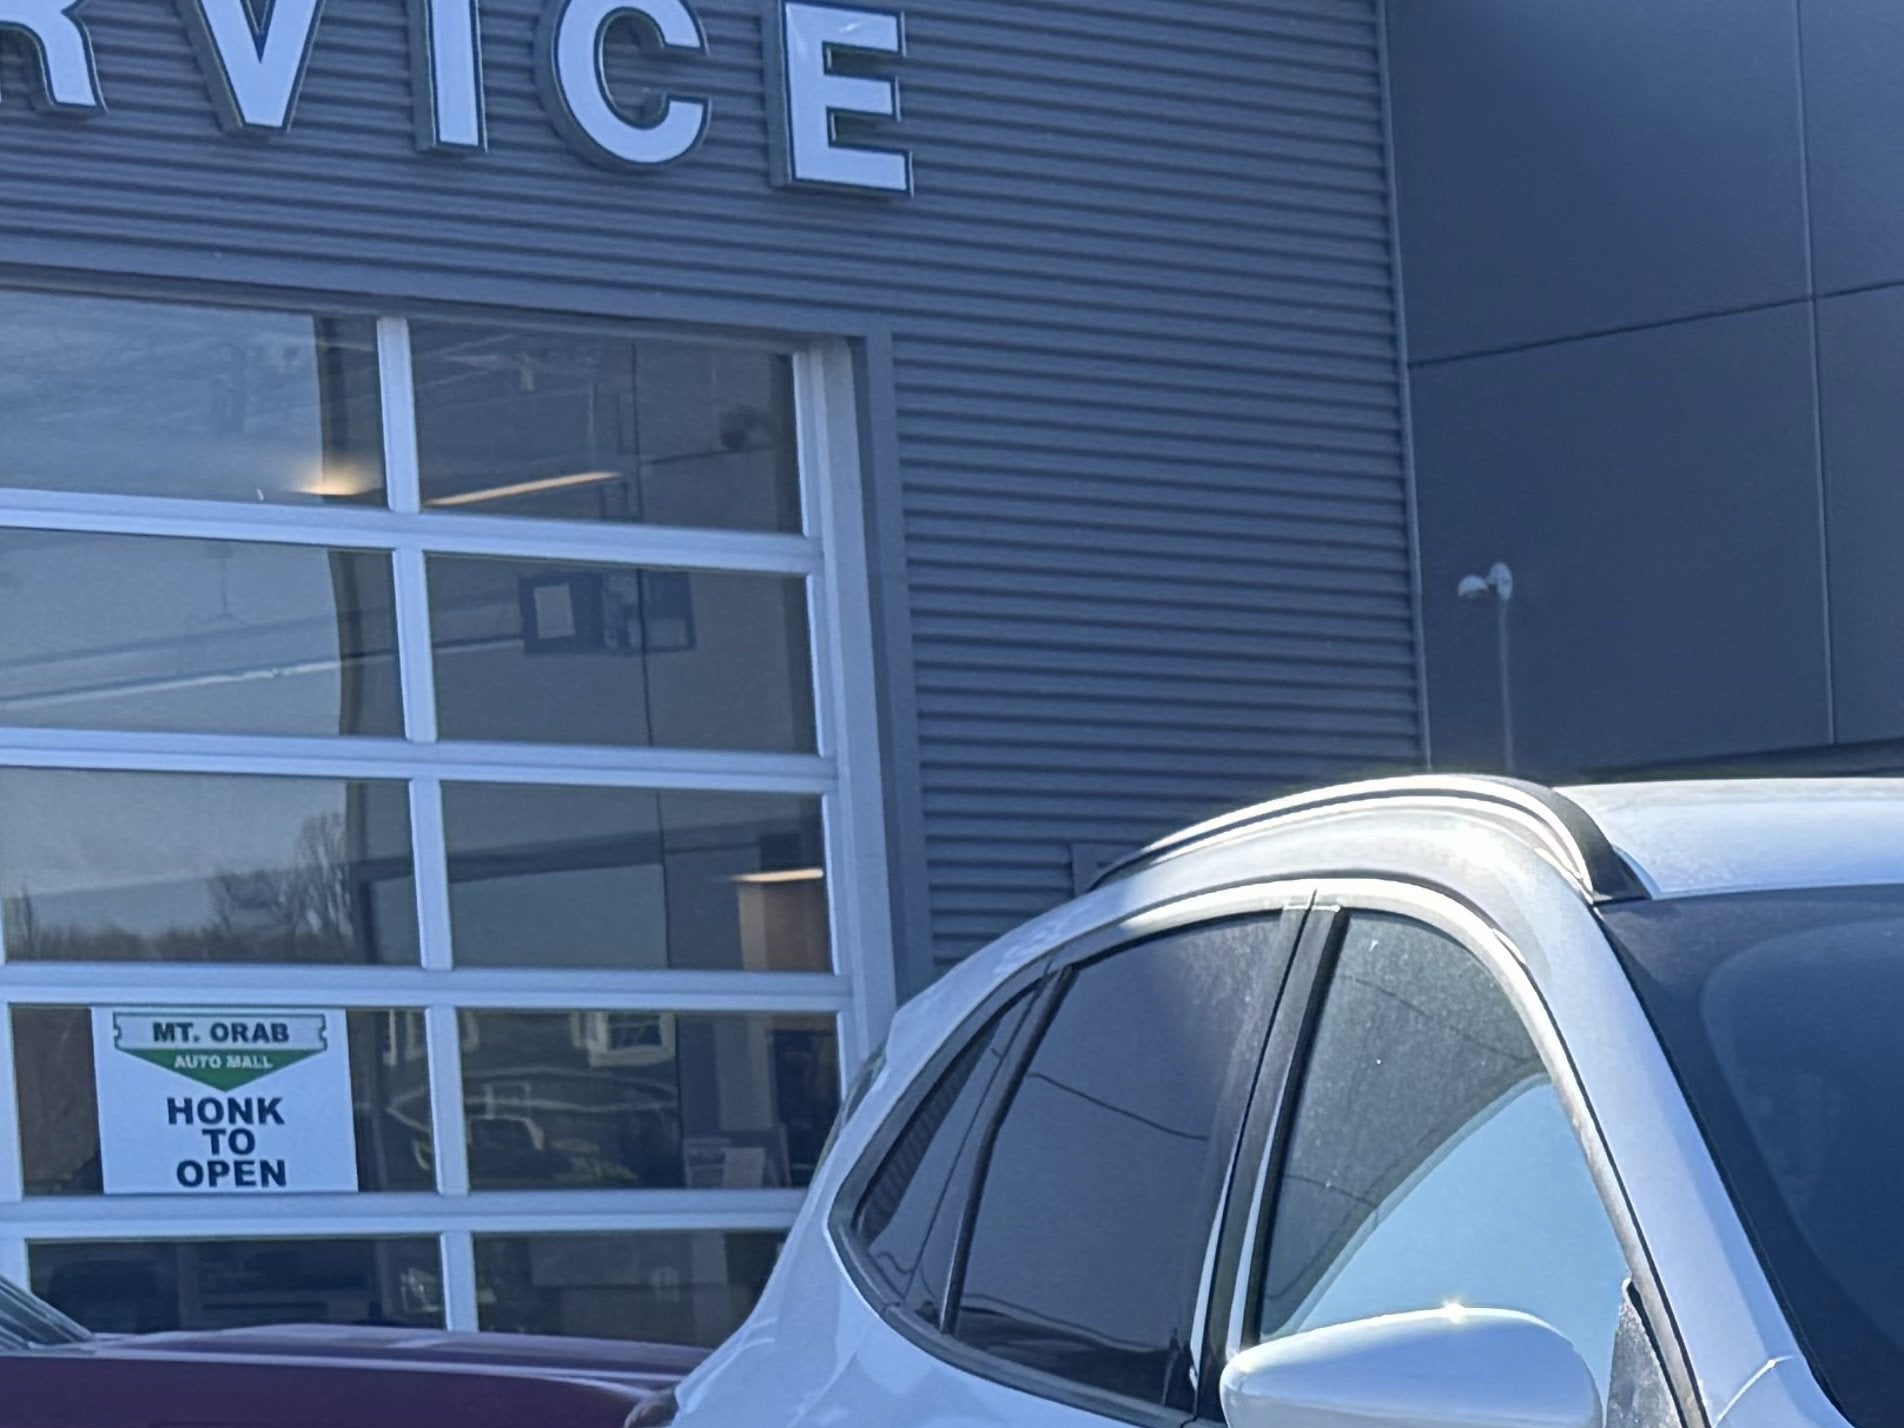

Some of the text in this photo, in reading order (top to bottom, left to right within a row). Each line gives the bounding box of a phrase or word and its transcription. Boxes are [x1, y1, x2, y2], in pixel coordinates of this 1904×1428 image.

[152, 1021, 290, 1043] MT. ORAB
[173, 1054, 273, 1069] AUTO MALL
[166, 1097, 285, 1125] HONK
[202, 1128, 256, 1156] TO
[176, 1159, 287, 1188] OPEN
